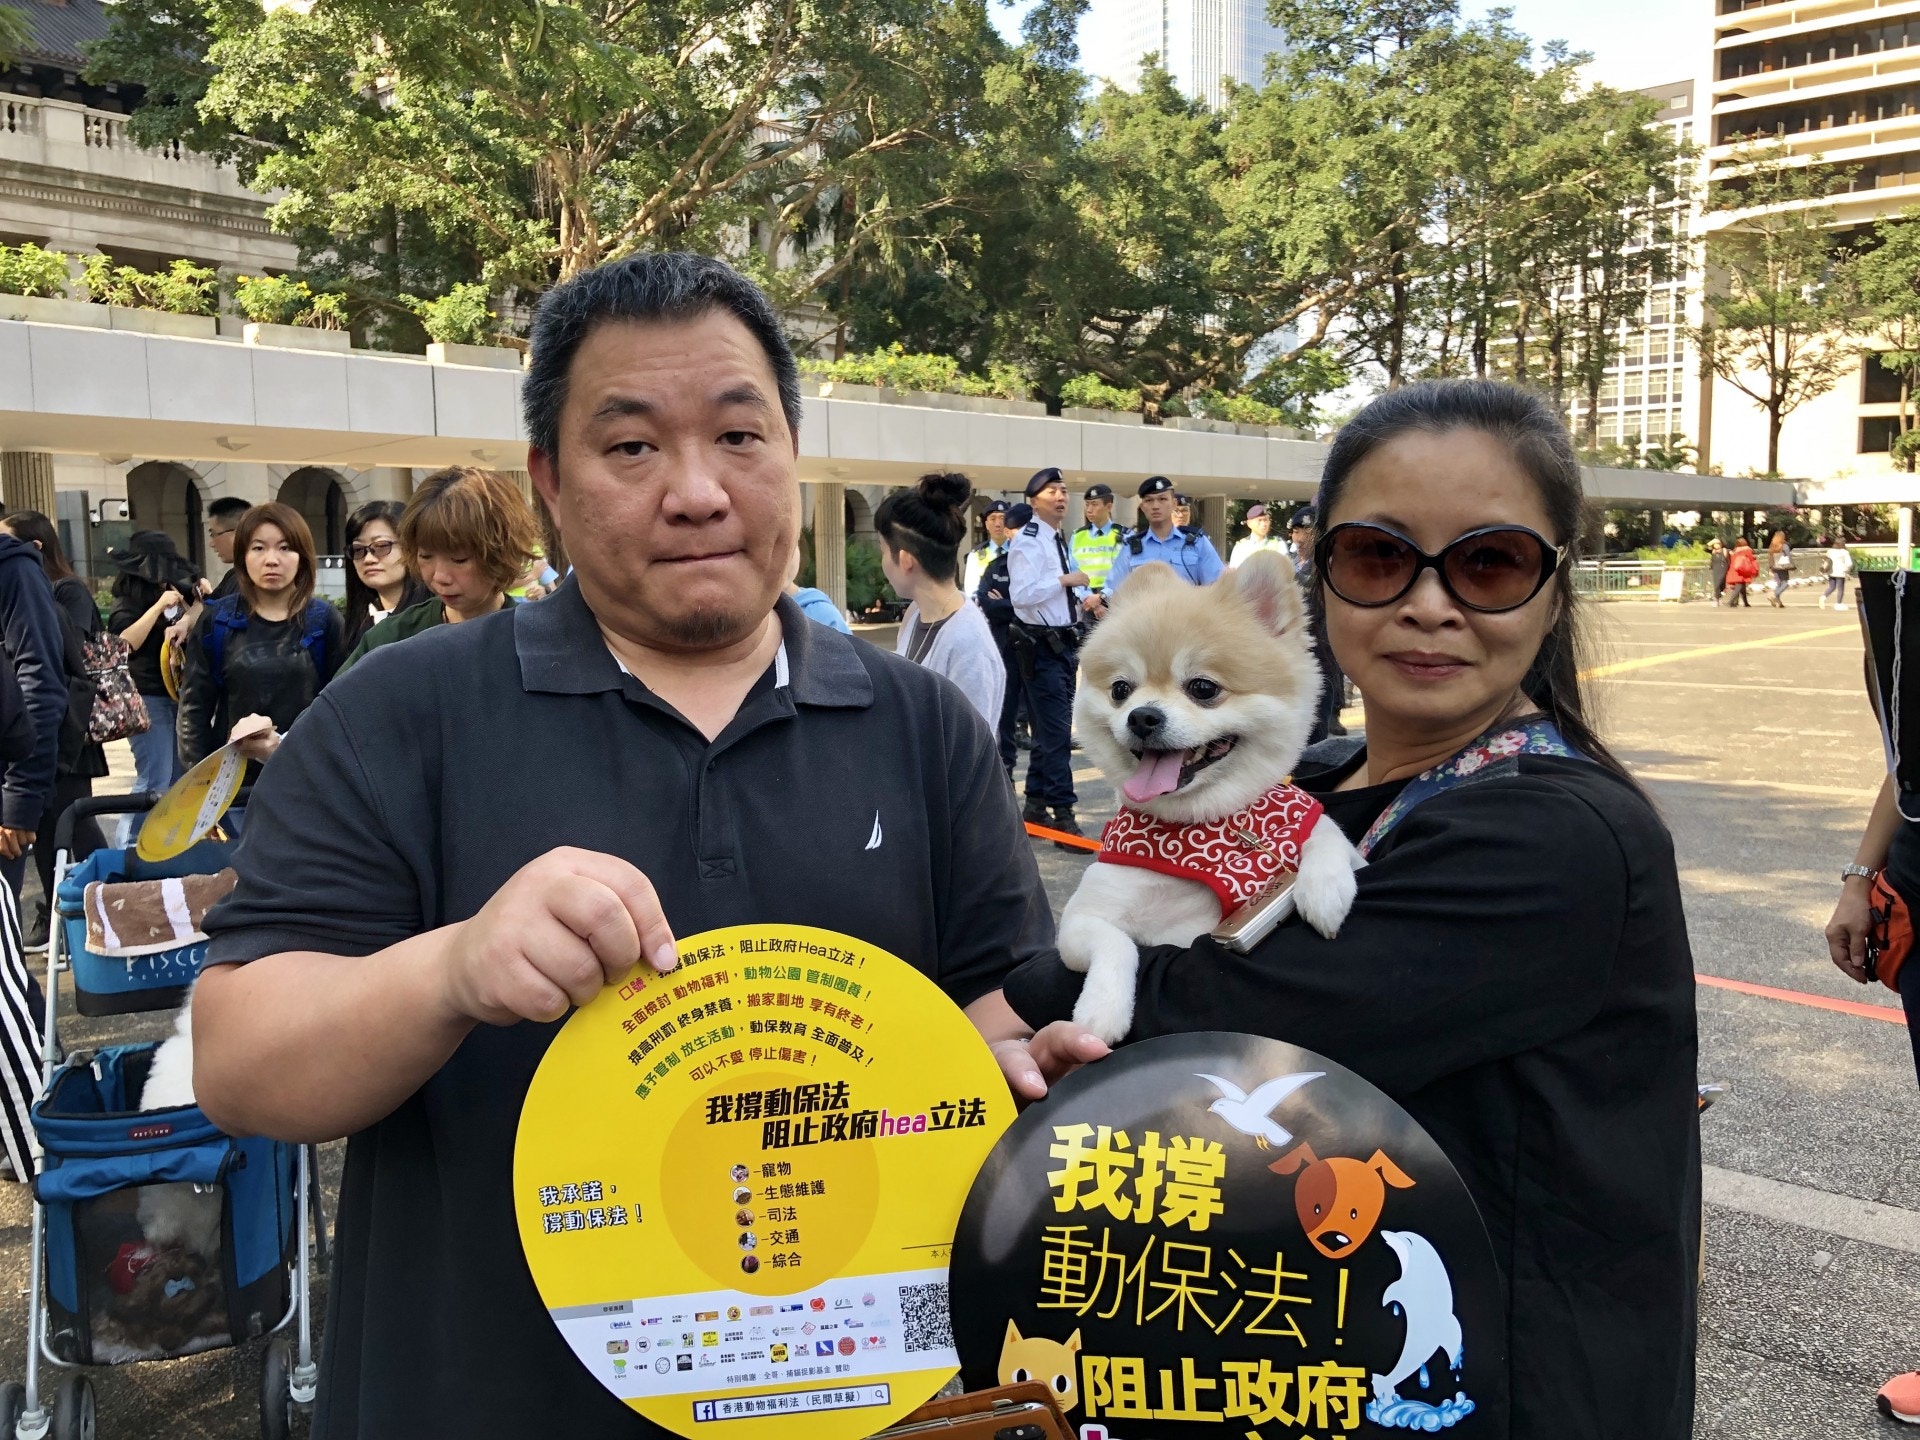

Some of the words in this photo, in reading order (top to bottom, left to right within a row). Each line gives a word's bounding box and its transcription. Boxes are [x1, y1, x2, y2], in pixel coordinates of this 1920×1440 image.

[621, 992, 672, 1035] 全面檢討
[628, 1021, 677, 1066] 提高刑罰
[688, 1049, 745, 1082] 可以不愛
[634, 1051, 682, 1101] 應予管制
[705, 1080, 851, 1125] 我撐動保法
[761, 1096, 987, 1151] 阻止政府hea立法
[1046, 1122, 1227, 1231] 我撐
[930, 1248, 952, 1259] 本人
[1036, 1223, 1350, 1349] 動保法！
[1081, 1354, 1367, 1430] 阻止政府
